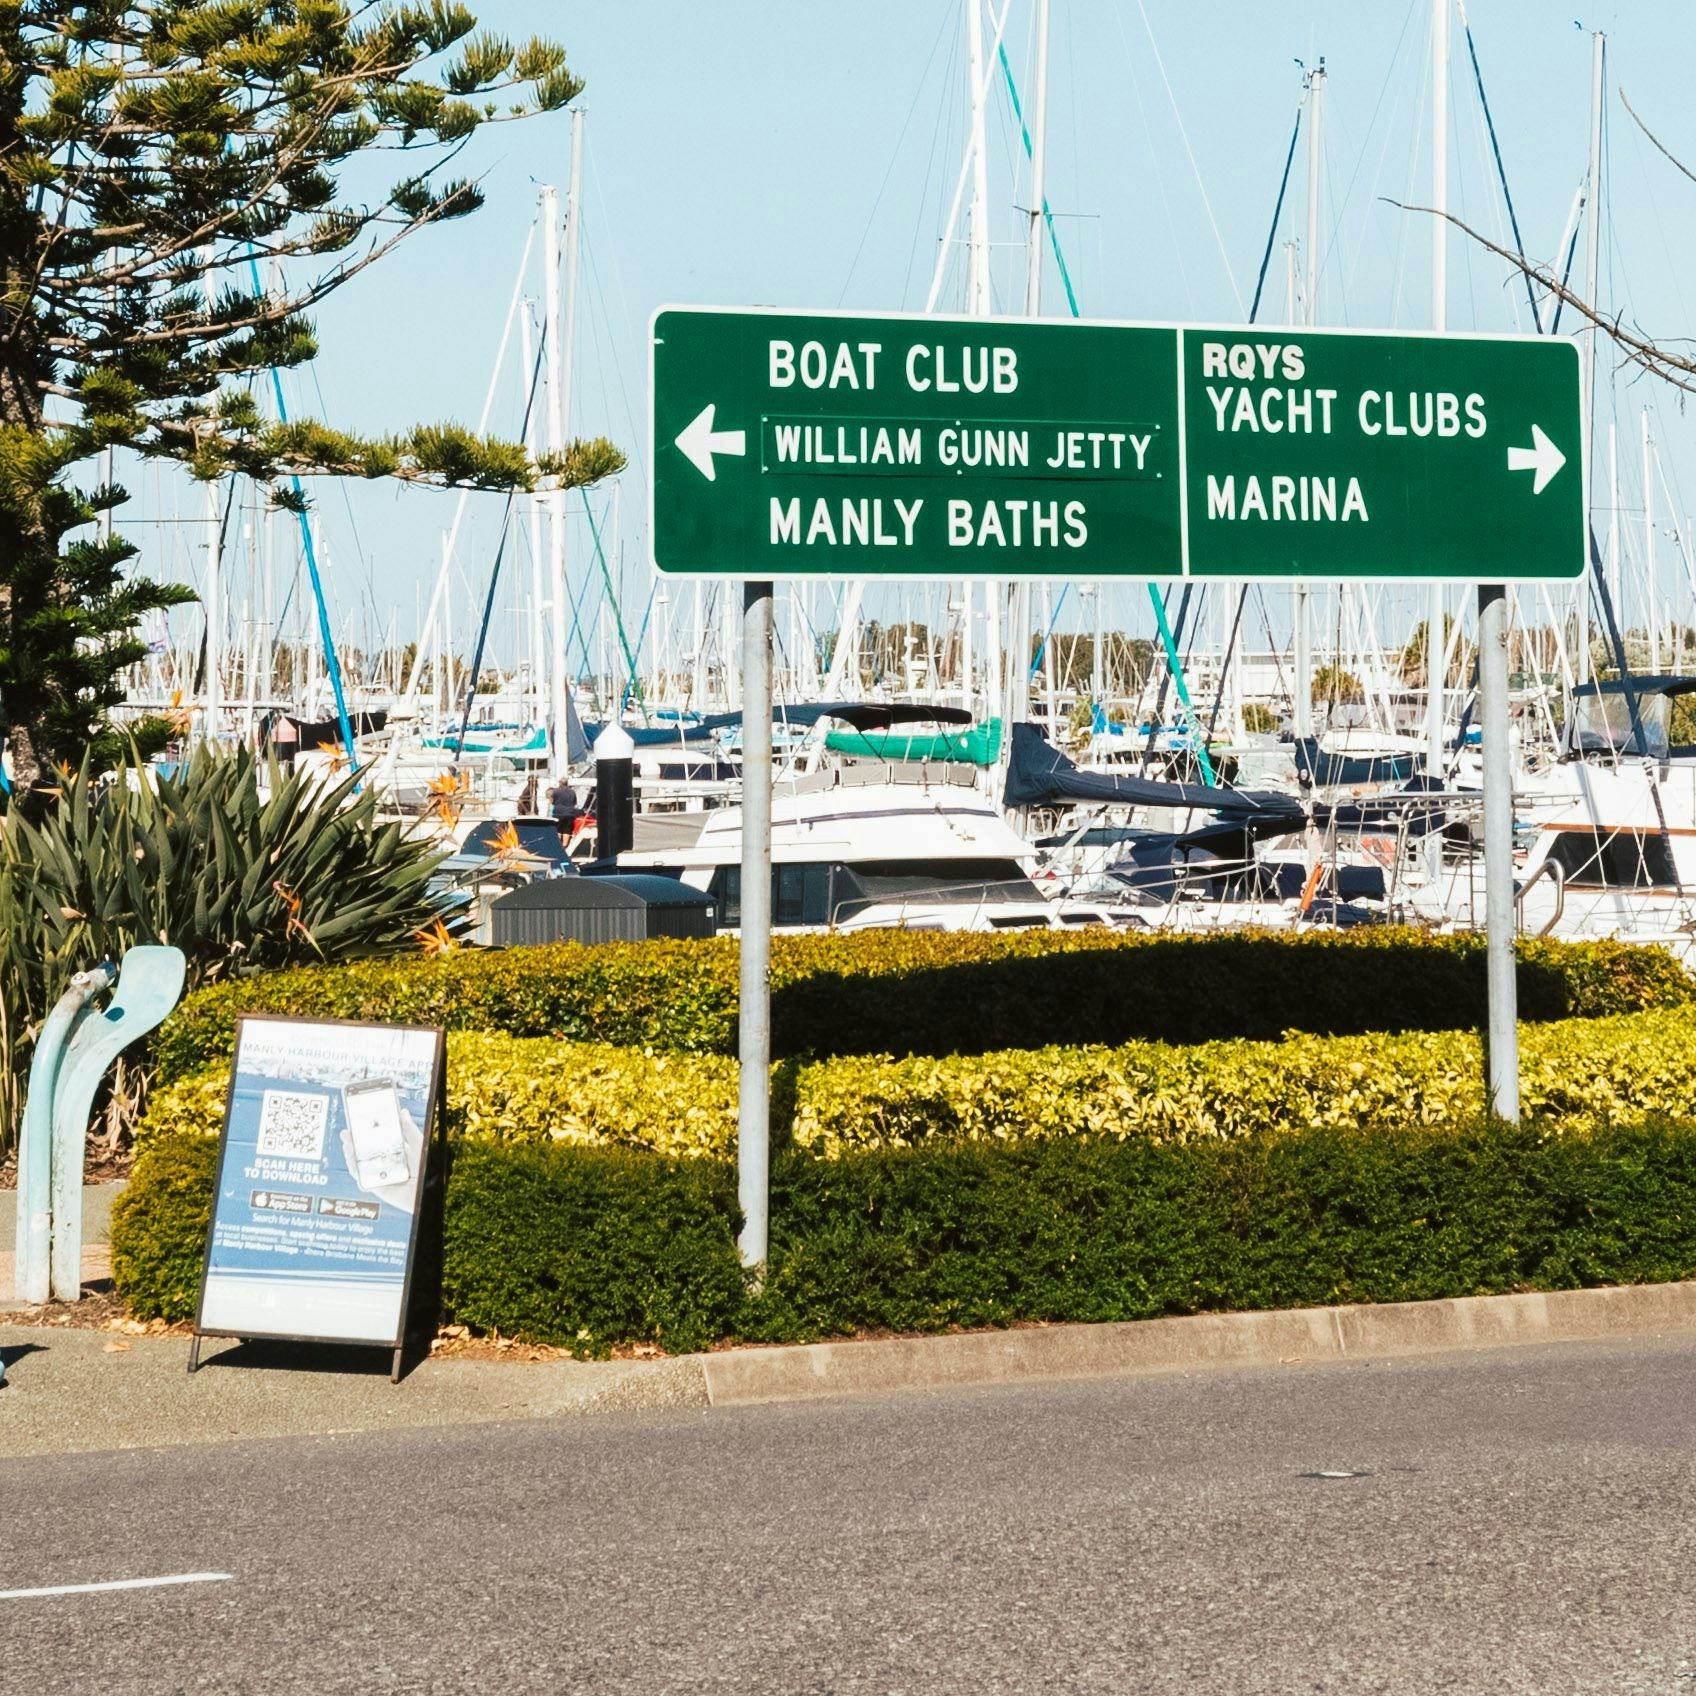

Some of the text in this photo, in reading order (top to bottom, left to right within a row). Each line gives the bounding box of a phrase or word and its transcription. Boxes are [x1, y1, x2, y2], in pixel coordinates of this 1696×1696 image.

[769, 340, 1019, 394] BOAT CLUB
[1202, 342, 1306, 382] RQYS
[1205, 386, 1487, 438] YACHT CLUBS
[774, 425, 1152, 470] WILLIAM GUNN JETTY
[1207, 474, 1369, 522] MARINA
[770, 497, 1088, 547] MANLY BATHS
[243, 1042, 285, 1056] MANLY
[287, 1047, 349, 1062] HARBOUR
[352, 1053, 405, 1067] VILLAGE
[244, 1167, 329, 1185] TO DOWNLOAD
[254, 1158, 321, 1174] SCAN HERE
[252, 1212, 278, 1223] Search
[347, 1222, 375, 1236] Village
